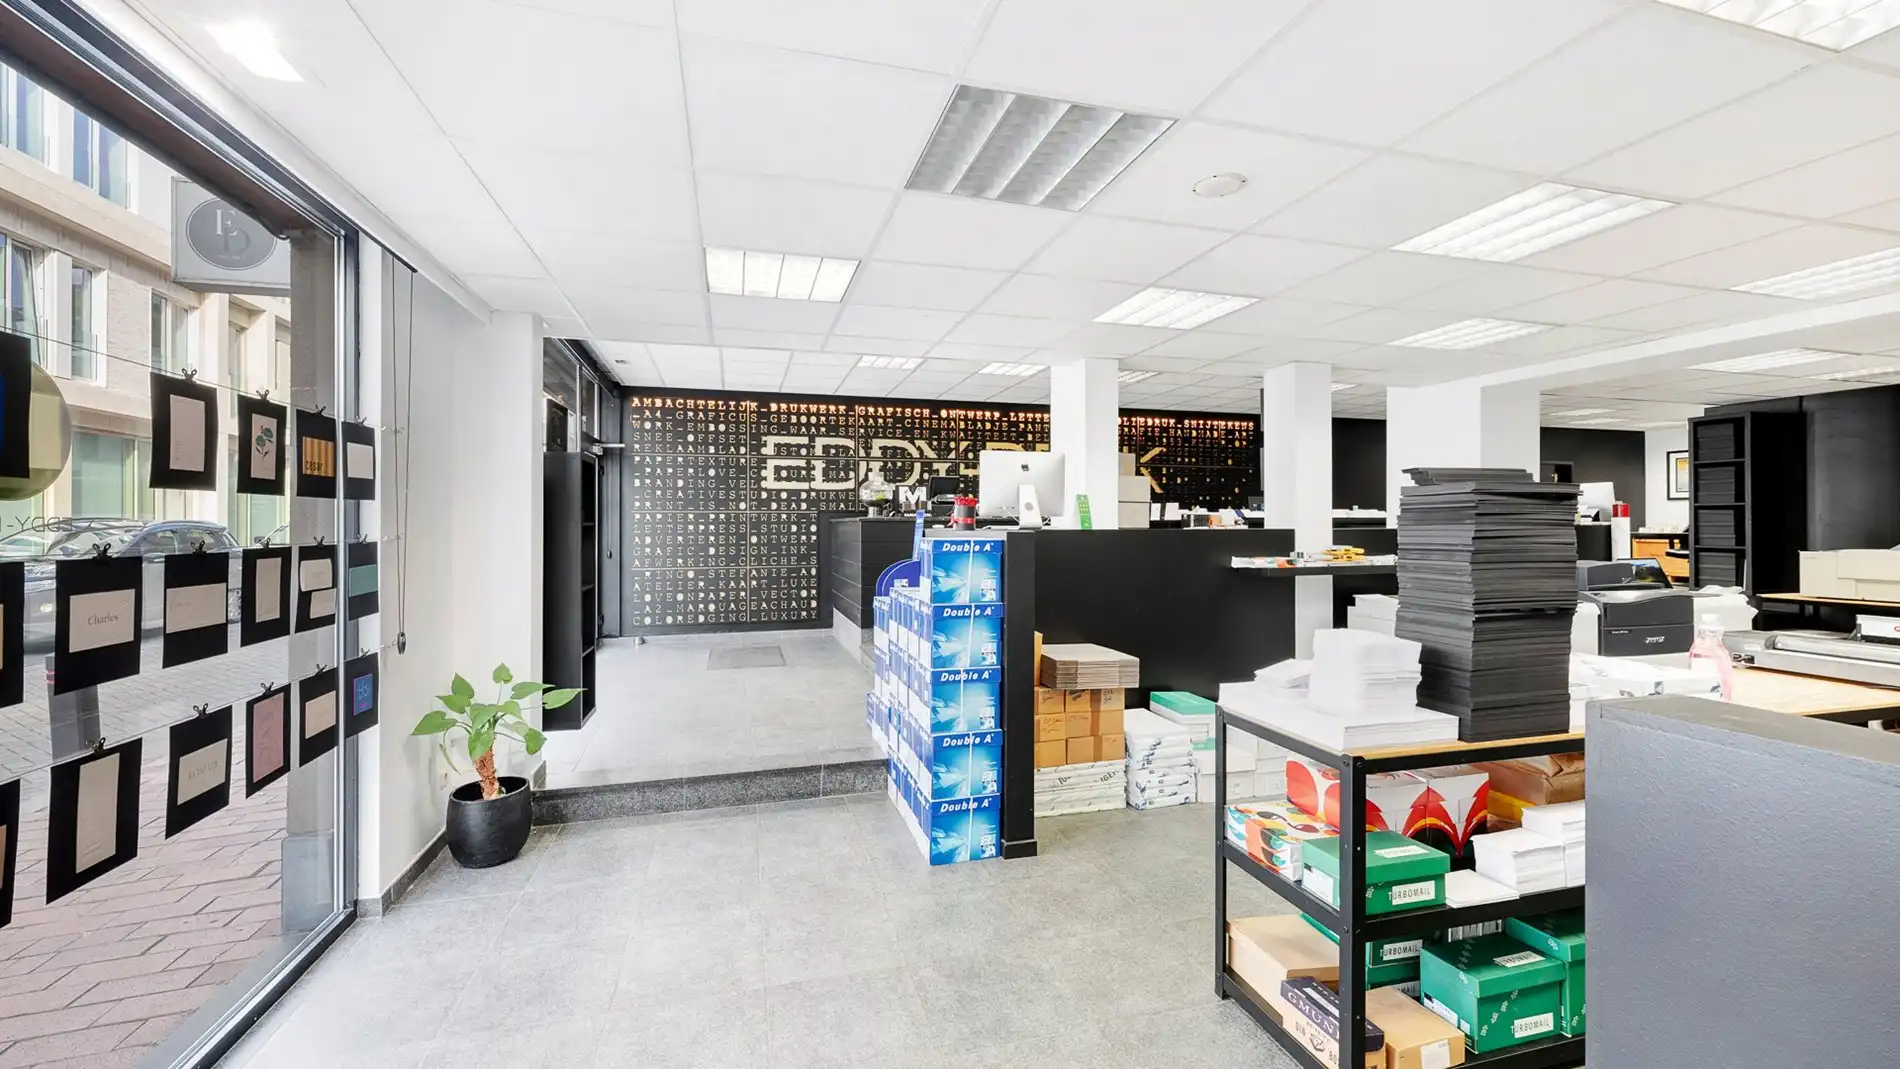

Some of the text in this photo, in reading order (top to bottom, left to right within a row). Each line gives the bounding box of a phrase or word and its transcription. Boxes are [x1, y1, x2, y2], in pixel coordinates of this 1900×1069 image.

[632, 398, 758, 412] AMBACHTELIJK
[770, 403, 847, 415] DRUKWERK
[858, 407, 931, 418] GRAFISCH
[940, 410, 1001, 421] ONTWERP
[1183, 420, 1255, 431] SNIJTEKENS
[643, 410, 663, 419] A4
[676, 411, 758, 422] GRAFICUS
[770, 414, 894, 427] GEBOORTEKAART
[904, 419, 1009, 431] CINEMABLADJE
[632, 421, 674, 430] WORK
[687, 422, 778, 434] EMBOSSING
[789, 425, 827, 435] WAAR
[838, 427, 903, 438] SERVICE
[913, 429, 931, 438] EN
[940, 430, 1017, 441] KWALITEIT
[632, 433, 747, 444] SNEE OFFSET
[632, 444, 747, 455] REKLAAMBLAD
[632, 456, 758, 467] PAPERTEXTURE
[643, 468, 736, 478] PAPERLOVE
[632, 479, 716, 488] BRANDING
[643, 490, 788, 500] CREATIVESTUDIO
[632, 501, 684, 510] PRINT
[697, 501, 716, 510] IS
[728, 501, 758, 510] NOT
[770, 502, 808, 510] DEAD
[632, 513, 695, 522] PAPIER
[708, 513, 798, 522] PRINTWERK
[632, 524, 818, 533] LETTERPRESS STUDIO
[632, 535, 818, 544] ADVERTEREN ONTWERP
[632, 545, 808, 556] GRAFIC DESIGN INK
[942, 542, 980, 552] Doube
[632, 557, 726, 567] AFWERKING
[738, 556, 798, 566] CLICHE
[643, 569, 695, 578] RINGO
[708, 567, 788, 577] STEFANIE
[632, 579, 818, 591] ATELIER KAART LUXE
[632, 589, 818, 602] LOVEONPAPER VECTOR
[643, 604, 663, 613] A2
[943, 607, 981, 617] Doube
[632, 611, 818, 625] COLOREDGING LUXURY
[940, 671, 978, 682] Double
[1388, 888, 1431, 901] TURBOMAIL
[1380, 944, 1419, 957] TURBOMAIL
[1510, 1020, 1550, 1035] TURBOMAIL
